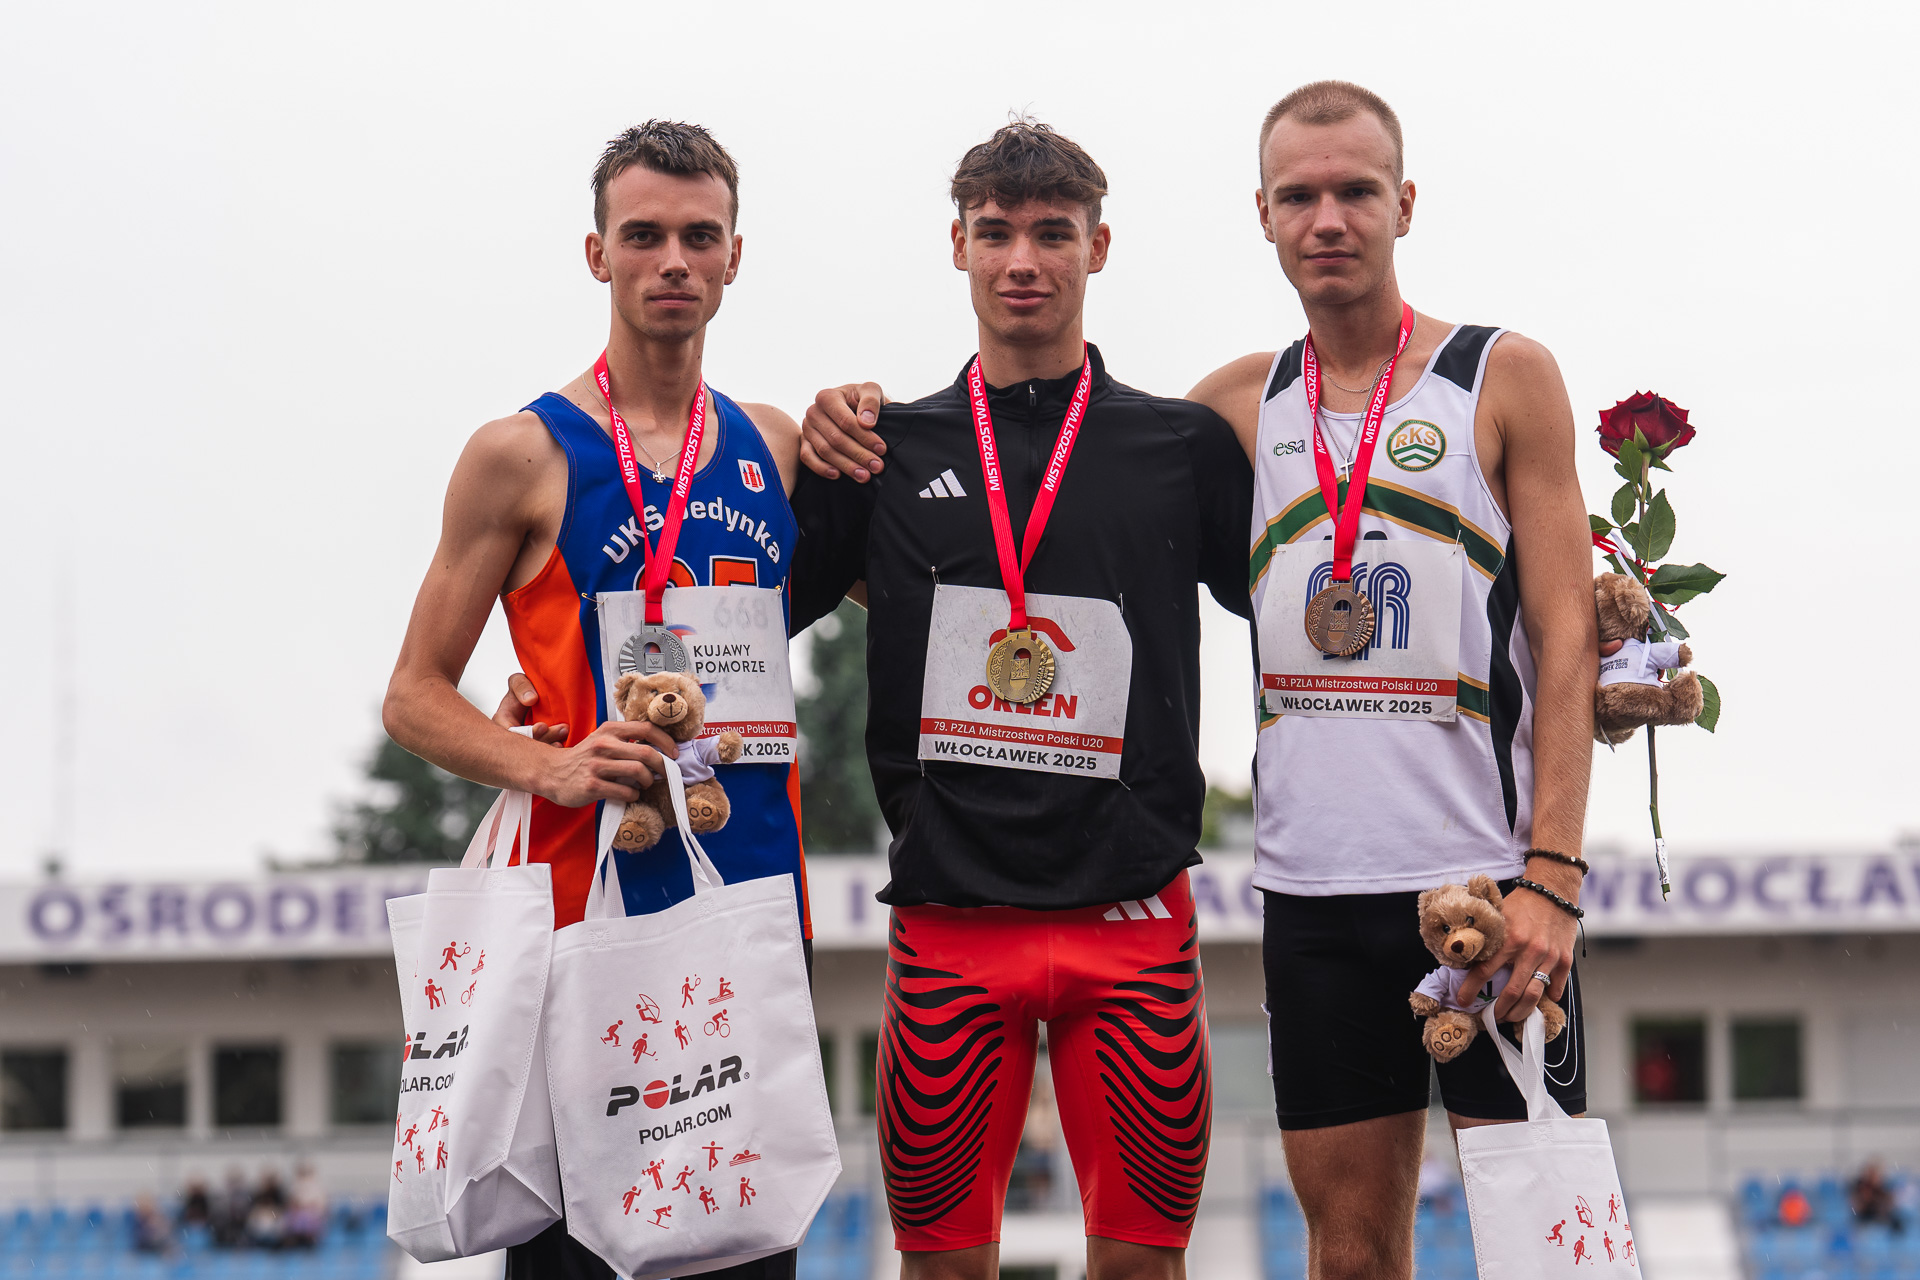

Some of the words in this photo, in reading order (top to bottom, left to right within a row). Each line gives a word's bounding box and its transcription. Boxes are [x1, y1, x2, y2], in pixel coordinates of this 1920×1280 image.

[974, 397, 1001, 491] MISTRZOSTWA
[1044, 402, 1083, 492] MISTRZOSTWA
[1395, 426, 1437, 448] RKS
[675, 413, 702, 498] MISTRZOSTWA
[602, 504, 664, 565] UKS
[693, 644, 751, 658] KUJAWY
[695, 660, 766, 674] POMORZE
[1275, 677, 1289, 687] 79.
[1290, 678, 1313, 688] PZLA
[1315, 678, 1379, 690] Mistrzostwa
[1381, 680, 1413, 691] Polski
[1415, 682, 1438, 692] U20
[1280, 696, 1384, 713] WŁOCŁAWEK
[1386, 699, 1433, 714] 2025
[699, 724, 745, 736] strzostwa
[746, 723, 772, 734] Polski
[773, 724, 789, 734] U20
[933, 721, 948, 732] 79.
[950, 723, 976, 735] PZLA
[978, 726, 1045, 742] Mistrzostwa
[1047, 733, 1079, 746] Polski
[1081, 738, 1104, 749] U20
[755, 742, 790, 756] 2025
[934, 740, 1050, 766] WŁOCŁAWEK
[1052, 753, 1097, 770] 2025
[606, 1055, 743, 1117] POLAR
[639, 1103, 732, 1145] POLAR.COM
